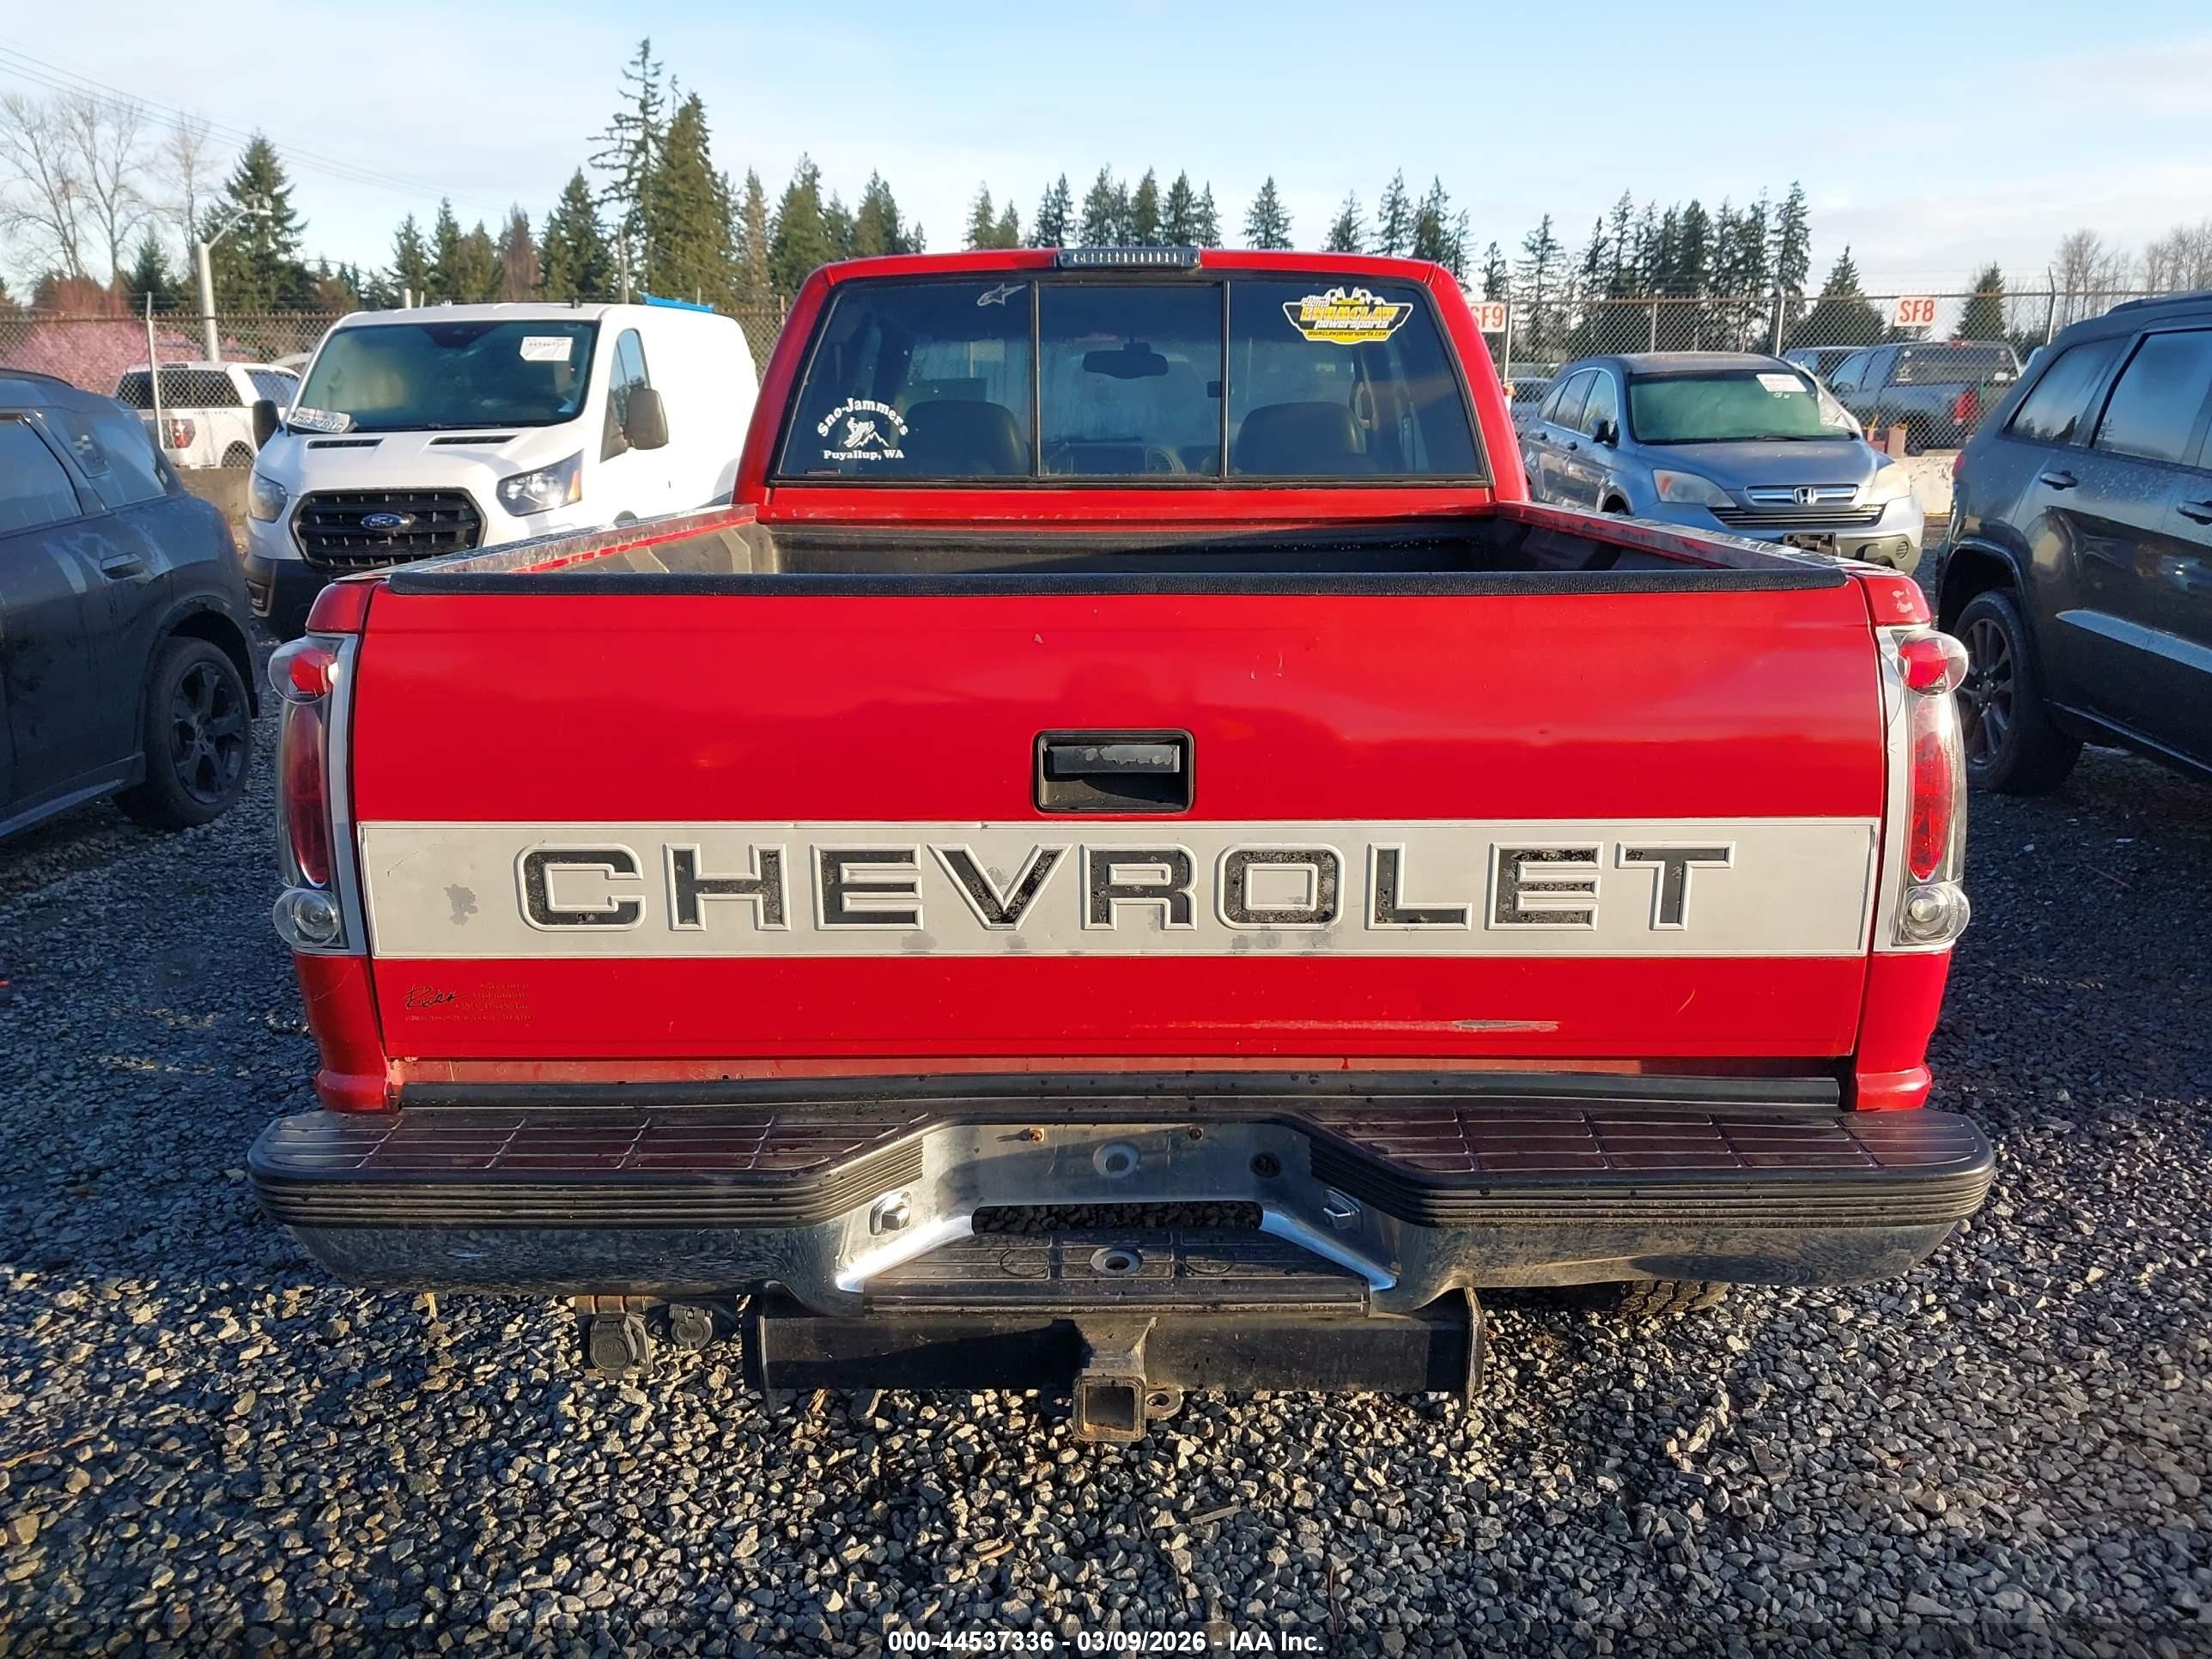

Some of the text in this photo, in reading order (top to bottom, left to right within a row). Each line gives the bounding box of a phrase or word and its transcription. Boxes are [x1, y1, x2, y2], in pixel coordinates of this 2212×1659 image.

[1899, 300, 1935, 322] SF8
[817, 398, 908, 437] Sno-Jammers
[823, 449, 905, 461] Puyallup, WA
[515, 840, 1735, 933] CHEVROLET
